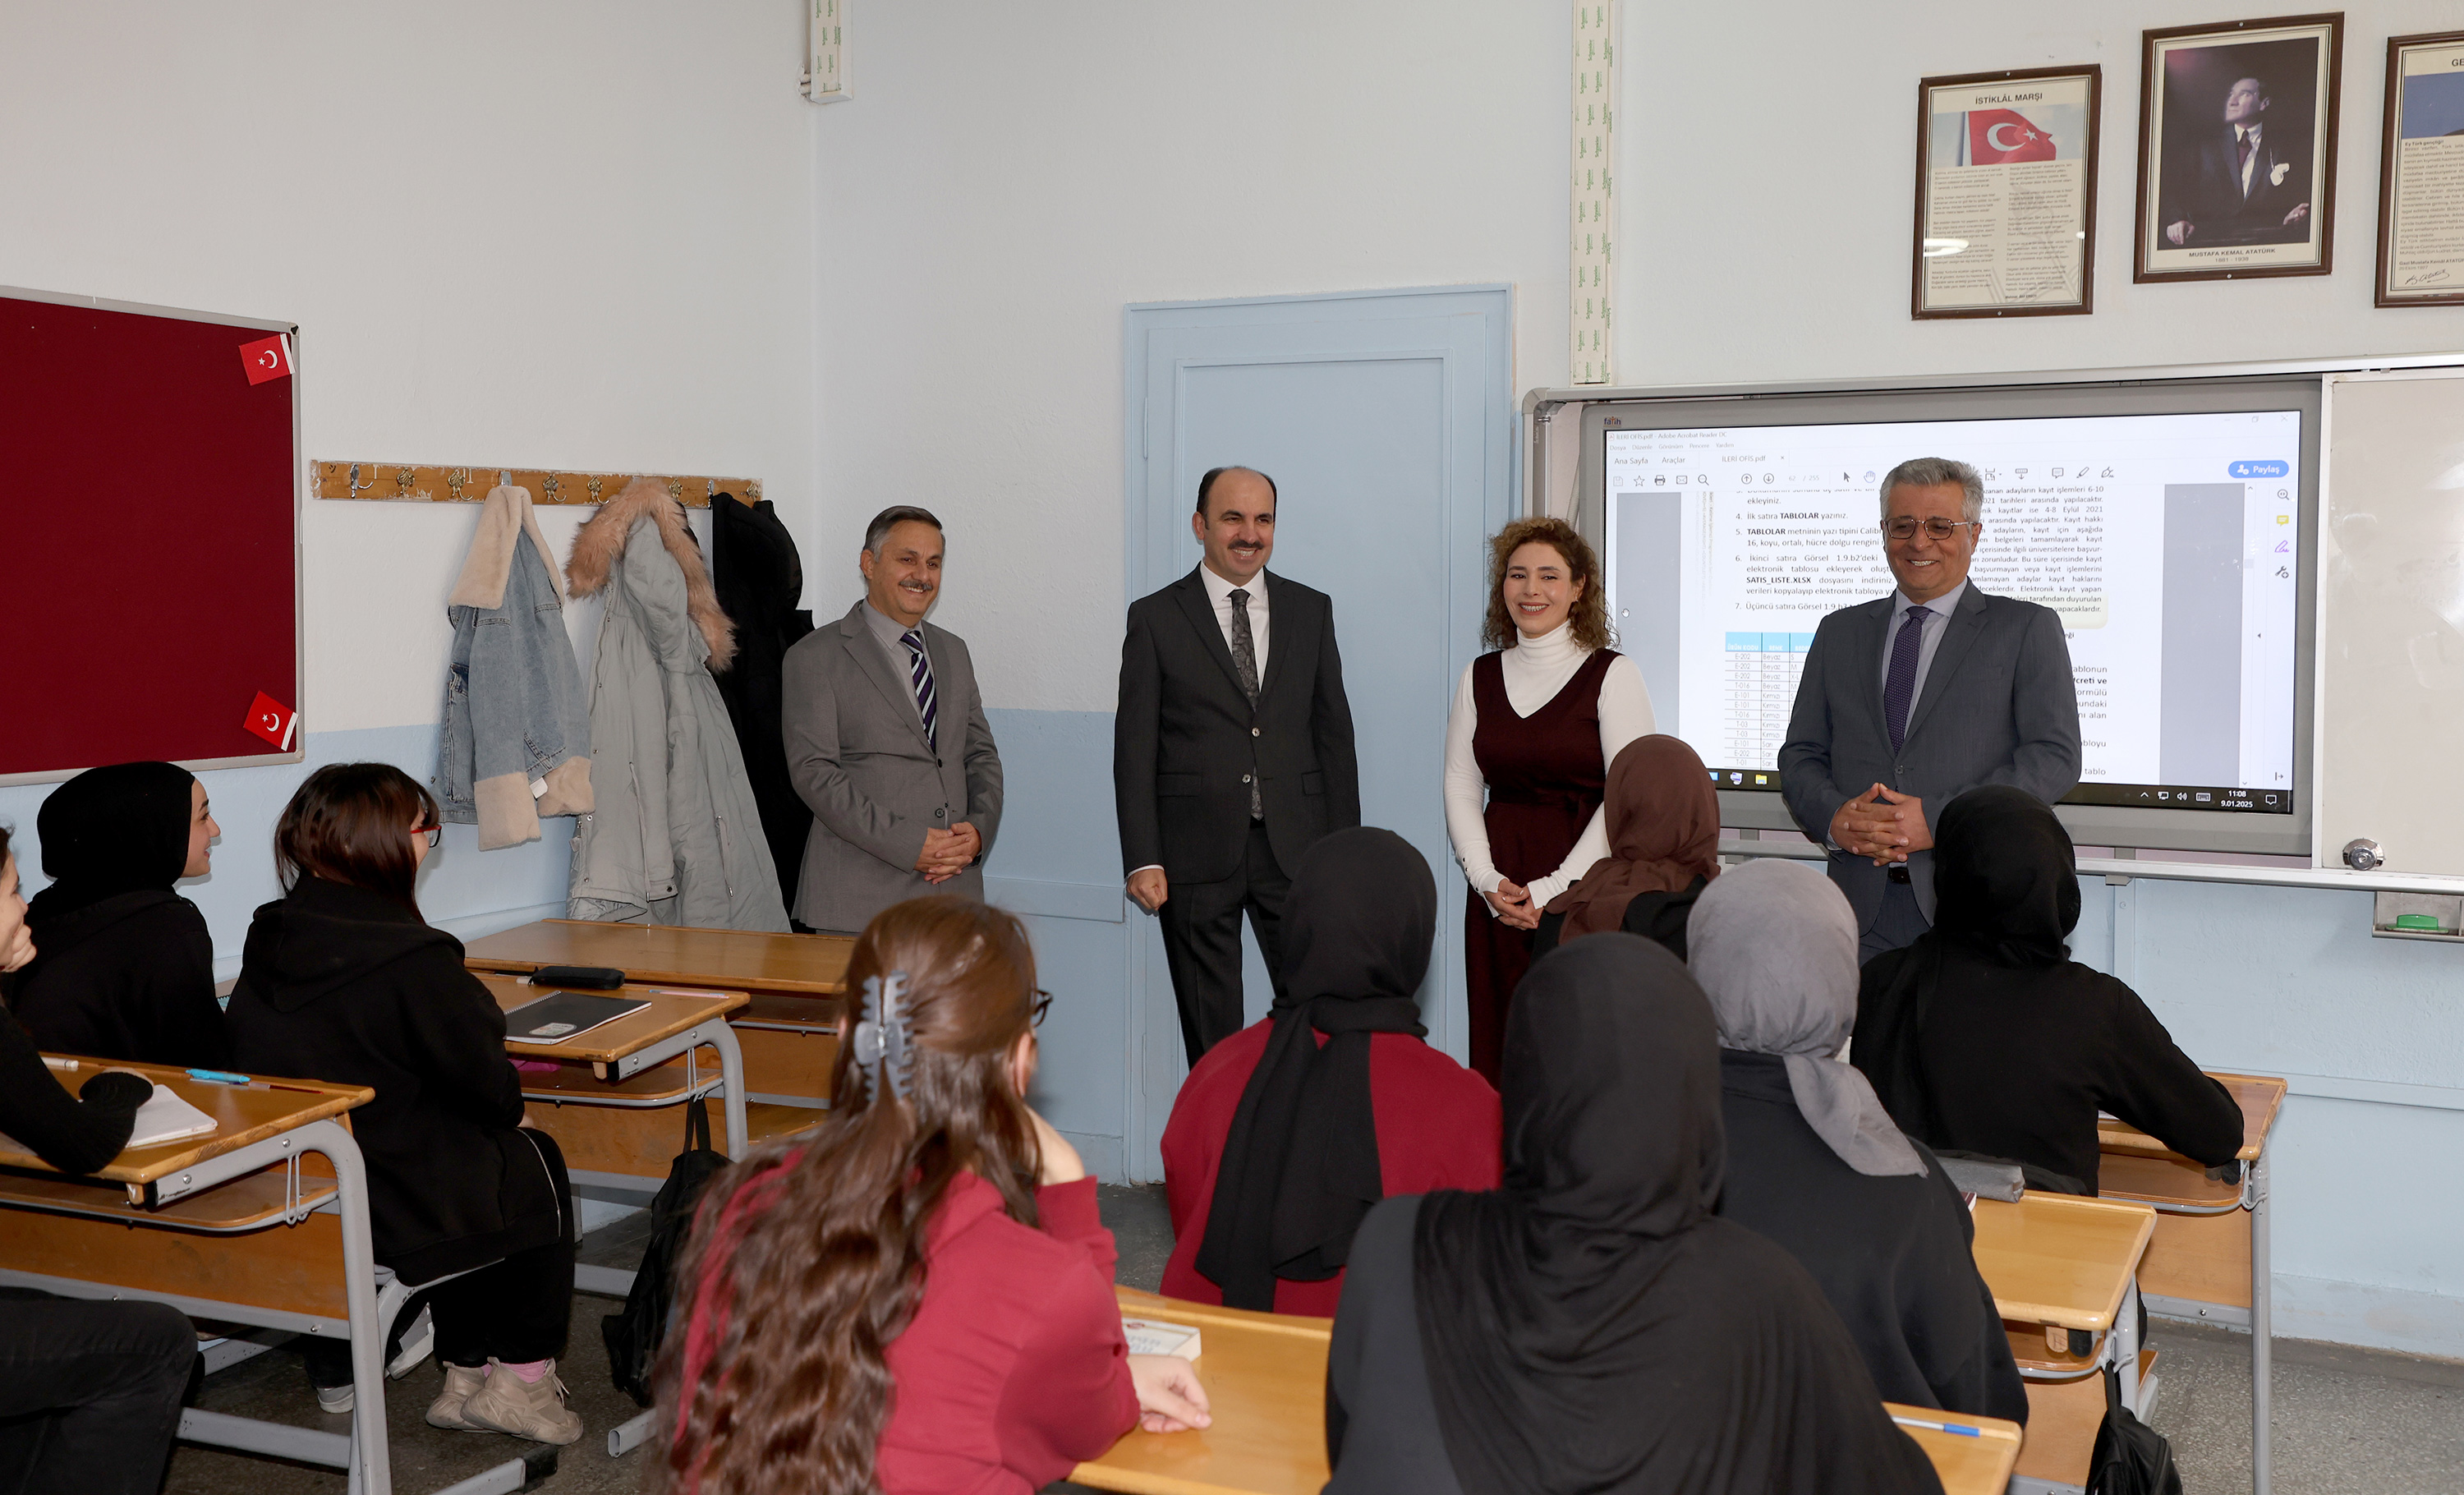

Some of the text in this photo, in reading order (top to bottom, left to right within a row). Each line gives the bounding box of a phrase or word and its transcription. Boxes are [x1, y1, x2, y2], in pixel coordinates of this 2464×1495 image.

[2015, 92, 2043, 101] MARŞI
[1603, 416, 1621, 426] fatih
[1662, 457, 1685, 465] Araçlar
[1739, 454, 1766, 463] OFİS.pdf
[2253, 464, 2280, 476] Paylaş
[2057, 485, 2085, 494] işlemleri
[1760, 539, 1780, 548] koyu,
[1829, 538, 1850, 547] dolgu
[1853, 538, 1879, 547] rengini
[1827, 565, 1863, 573] ekleyerek
[1855, 587, 1883, 596] tabloya
[1746, 601, 1773, 610] Üçüncü
[2221, 800, 2253, 808] 9.01.2025
